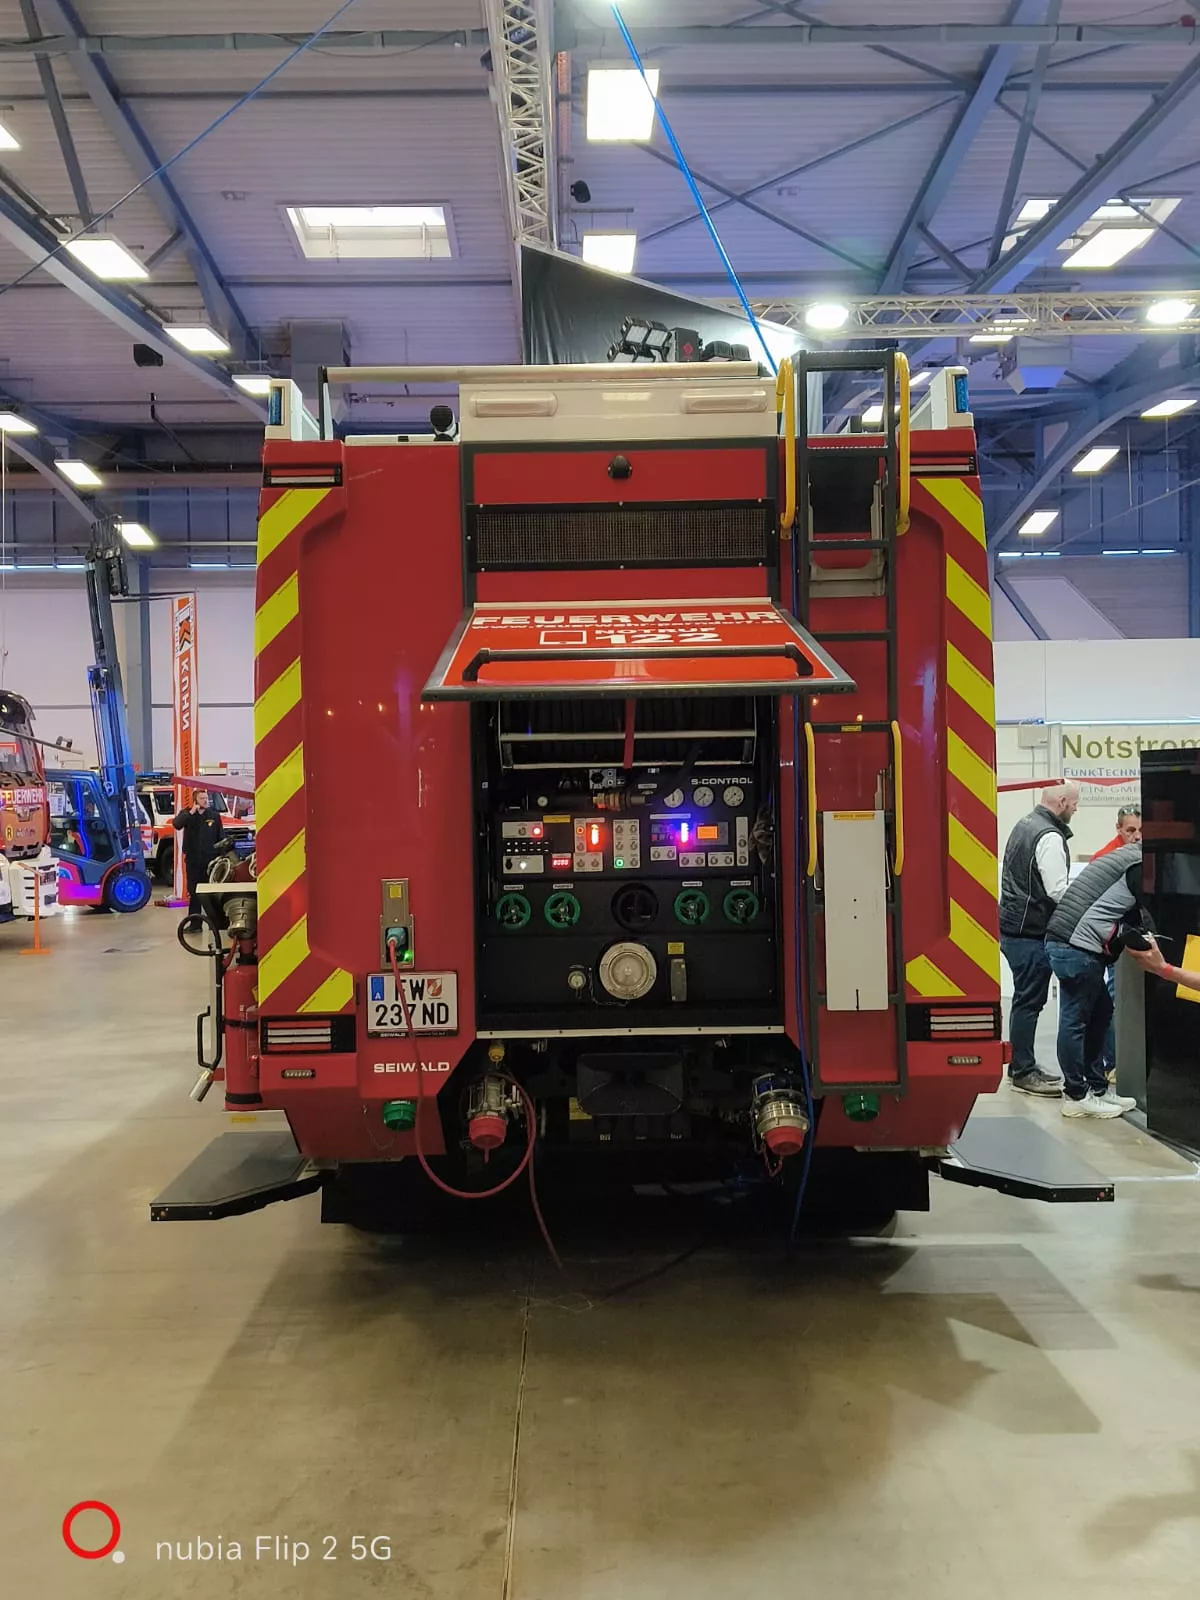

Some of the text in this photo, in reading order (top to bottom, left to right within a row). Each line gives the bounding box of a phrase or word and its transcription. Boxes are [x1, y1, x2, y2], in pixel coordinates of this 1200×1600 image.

[472, 611, 781, 625] FEUERWEHR
[595, 632, 722, 644] 122
[690, 777, 753, 785] S-CONTROL
[1, 788, 43, 805] FEUERWEHR
[374, 992, 381, 1000] A
[394, 978, 425, 1001] FW
[375, 1002, 450, 1026] 237 ND
[373, 1062, 450, 1073] SEIWALD
